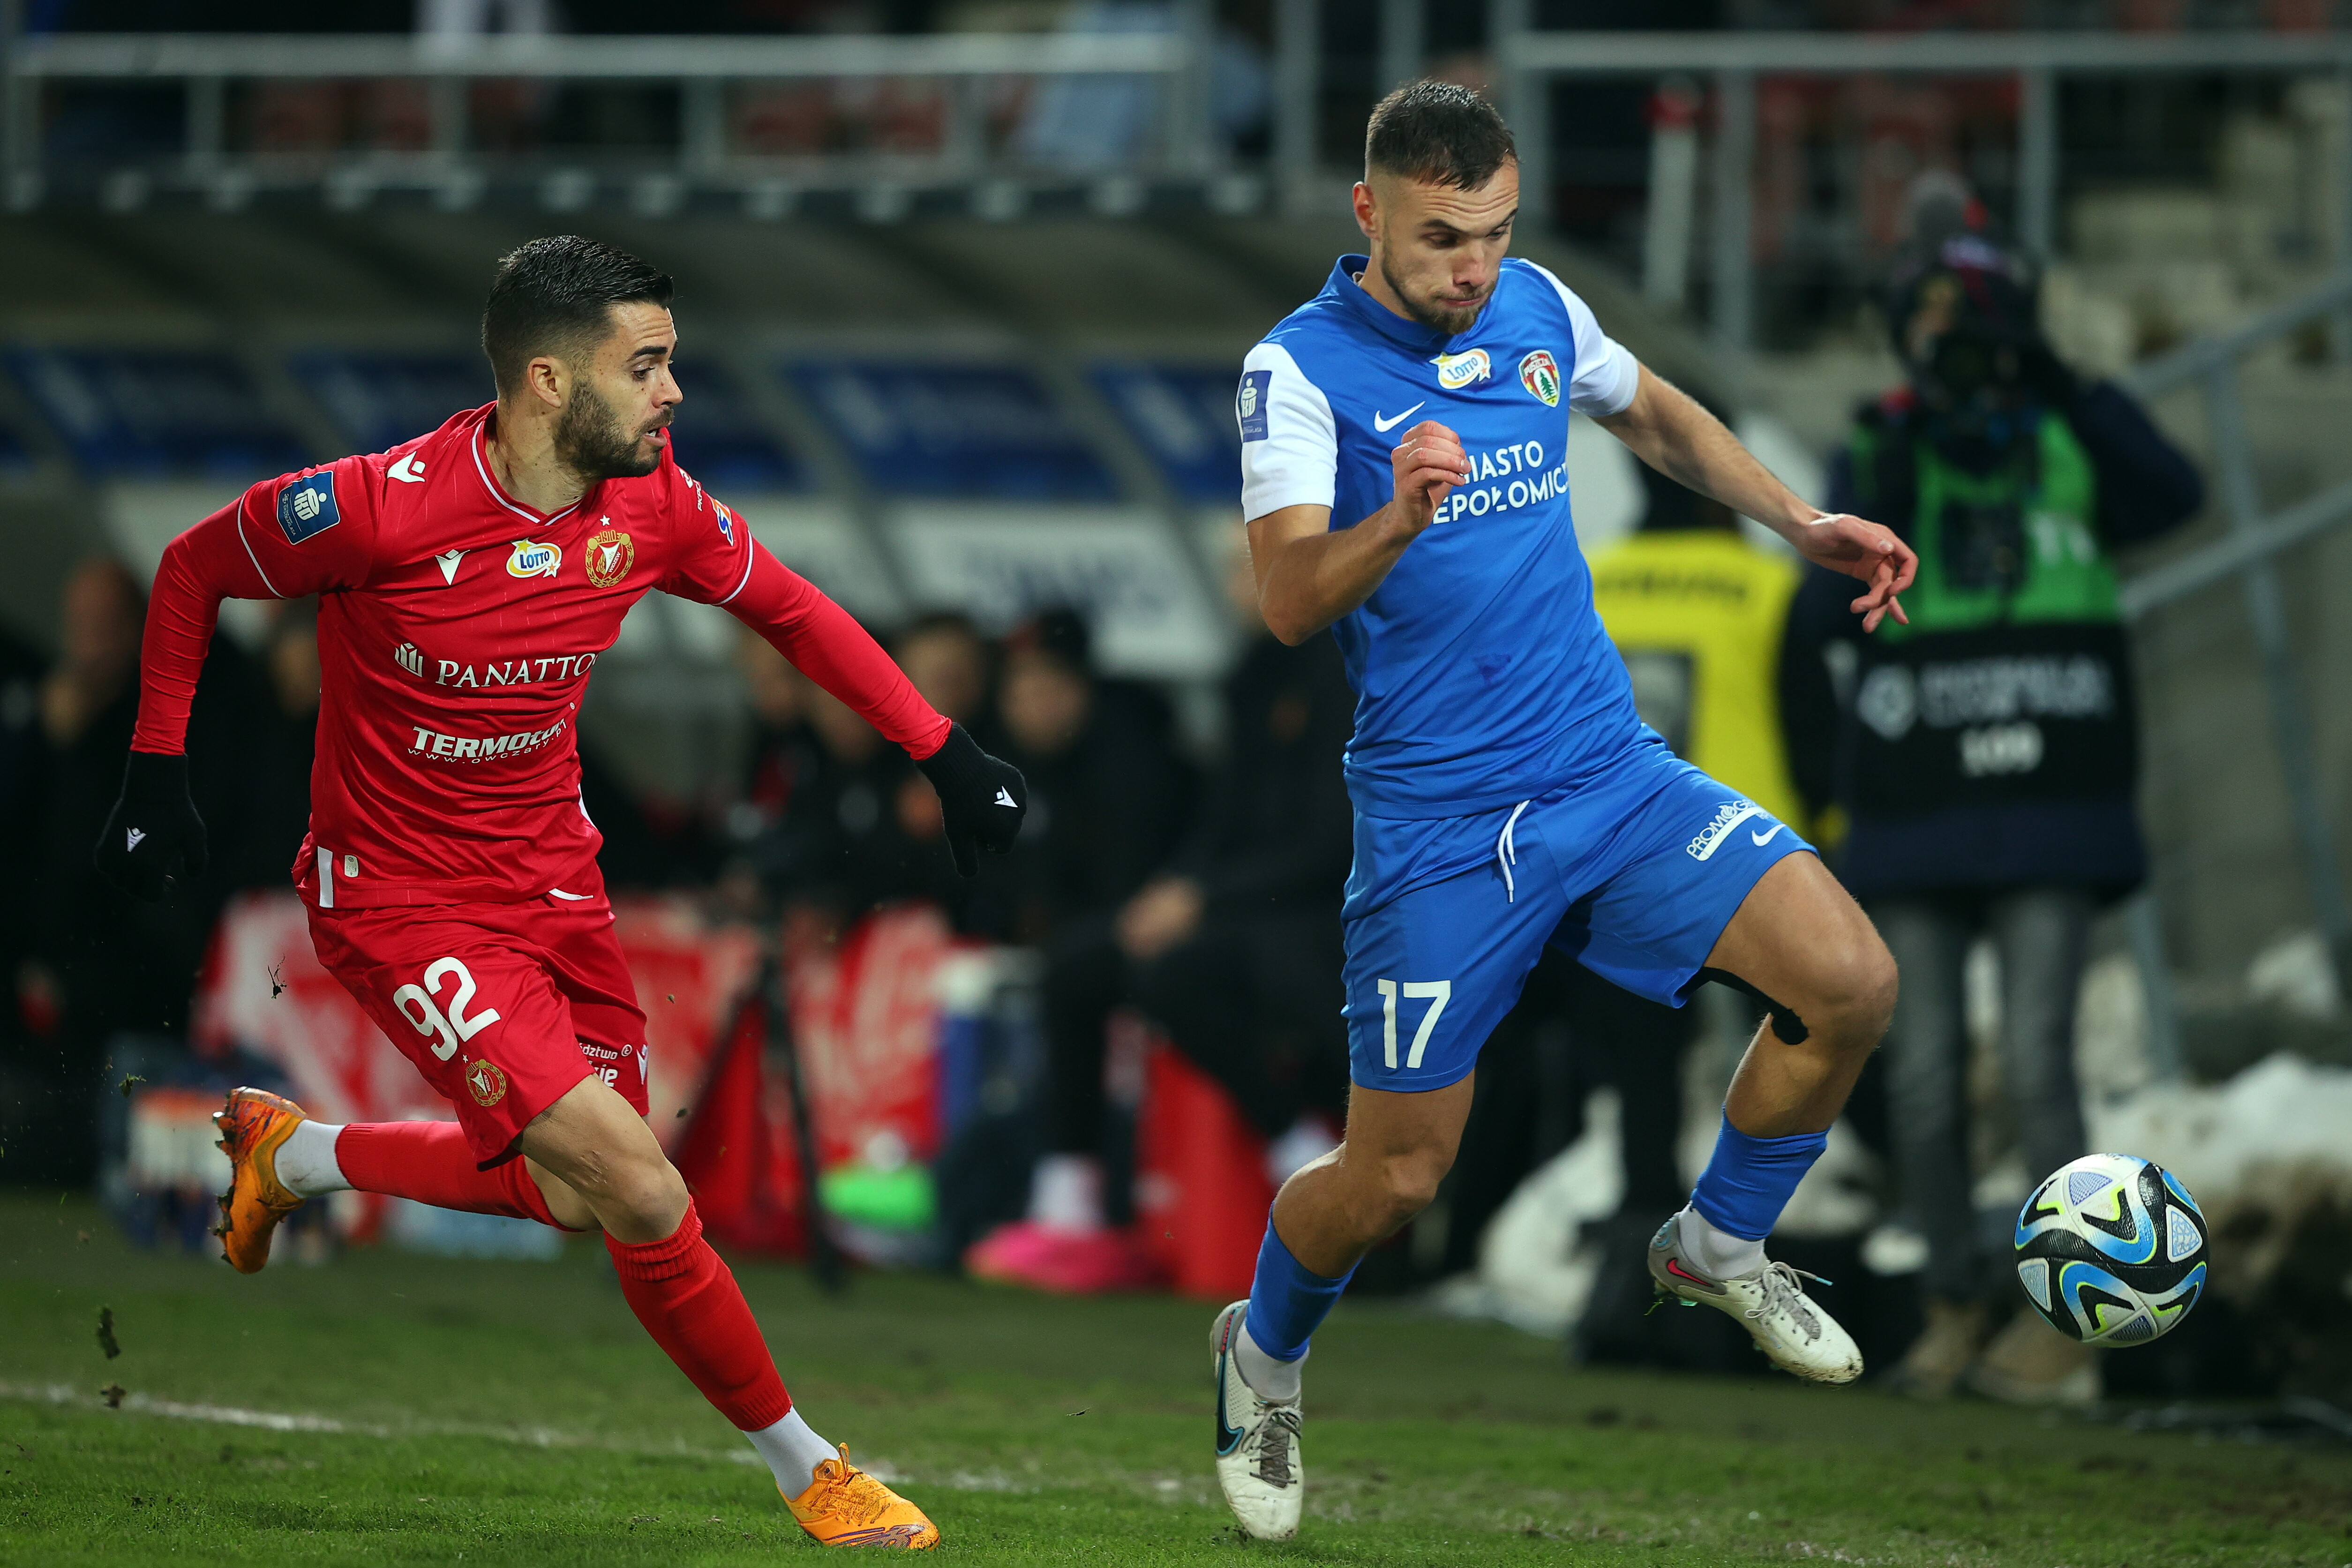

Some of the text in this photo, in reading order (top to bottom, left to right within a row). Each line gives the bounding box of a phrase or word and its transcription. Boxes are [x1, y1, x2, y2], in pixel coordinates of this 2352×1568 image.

[1447, 357, 1478, 380] LOTTO
[1433, 462, 1569, 524] EPOŁOMIC
[600, 530, 616, 542] 1910
[520, 551, 549, 569] LOTTO
[608, 552, 621, 573] WIDZEW
[436, 653, 599, 687] PANATTO
[408, 721, 566, 764] www.owczary.pl
[393, 957, 501, 1061] 92
[1378, 978, 1451, 1069] 17
